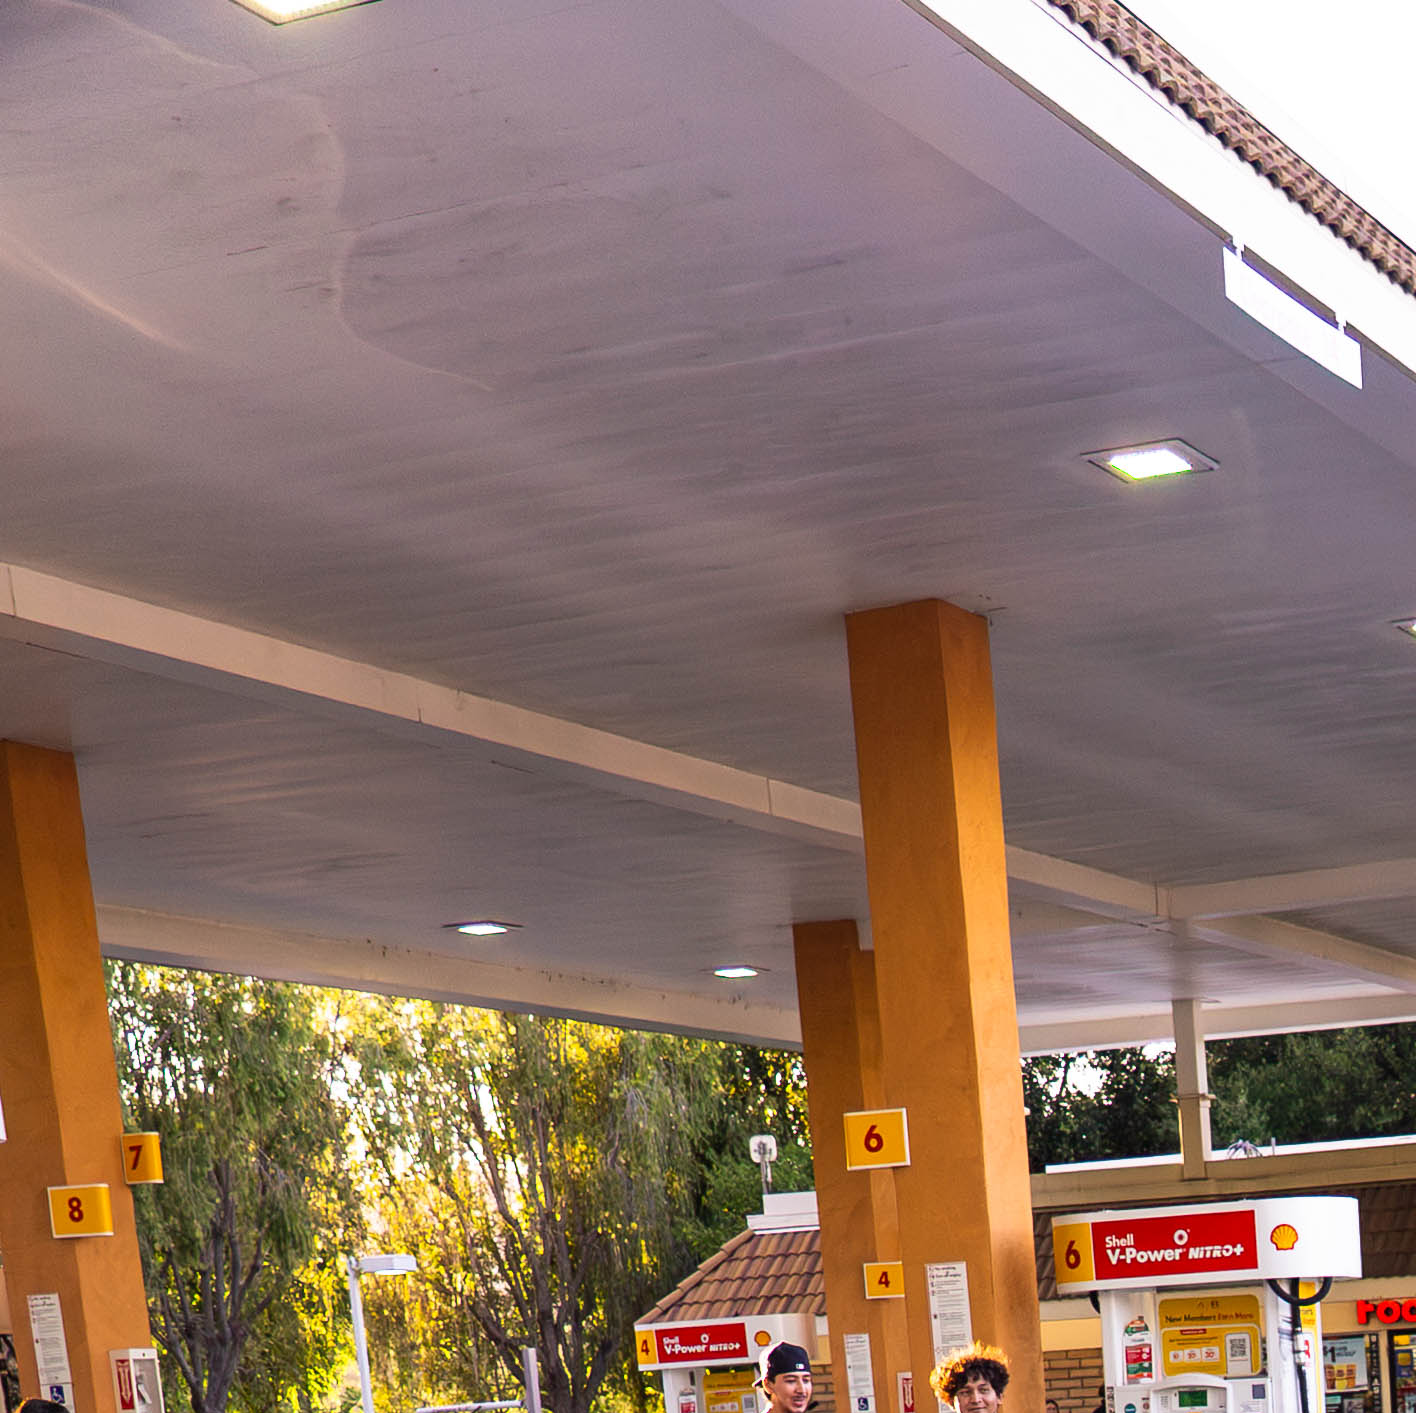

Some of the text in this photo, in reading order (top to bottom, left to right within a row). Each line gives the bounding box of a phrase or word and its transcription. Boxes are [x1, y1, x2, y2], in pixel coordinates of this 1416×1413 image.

[864, 1125, 884, 1153] 6
[129, 1145, 143, 1170] 7
[68, 1197, 84, 1222] 8
[1105, 1233, 1134, 1248] Shell
[1065, 1240, 1081, 1269] 6
[1106, 1247, 1182, 1265] V-Power
[878, 1271, 890, 1288] 4
[641, 1339, 650, 1355] 4
[664, 1343, 707, 1355] V-Power
